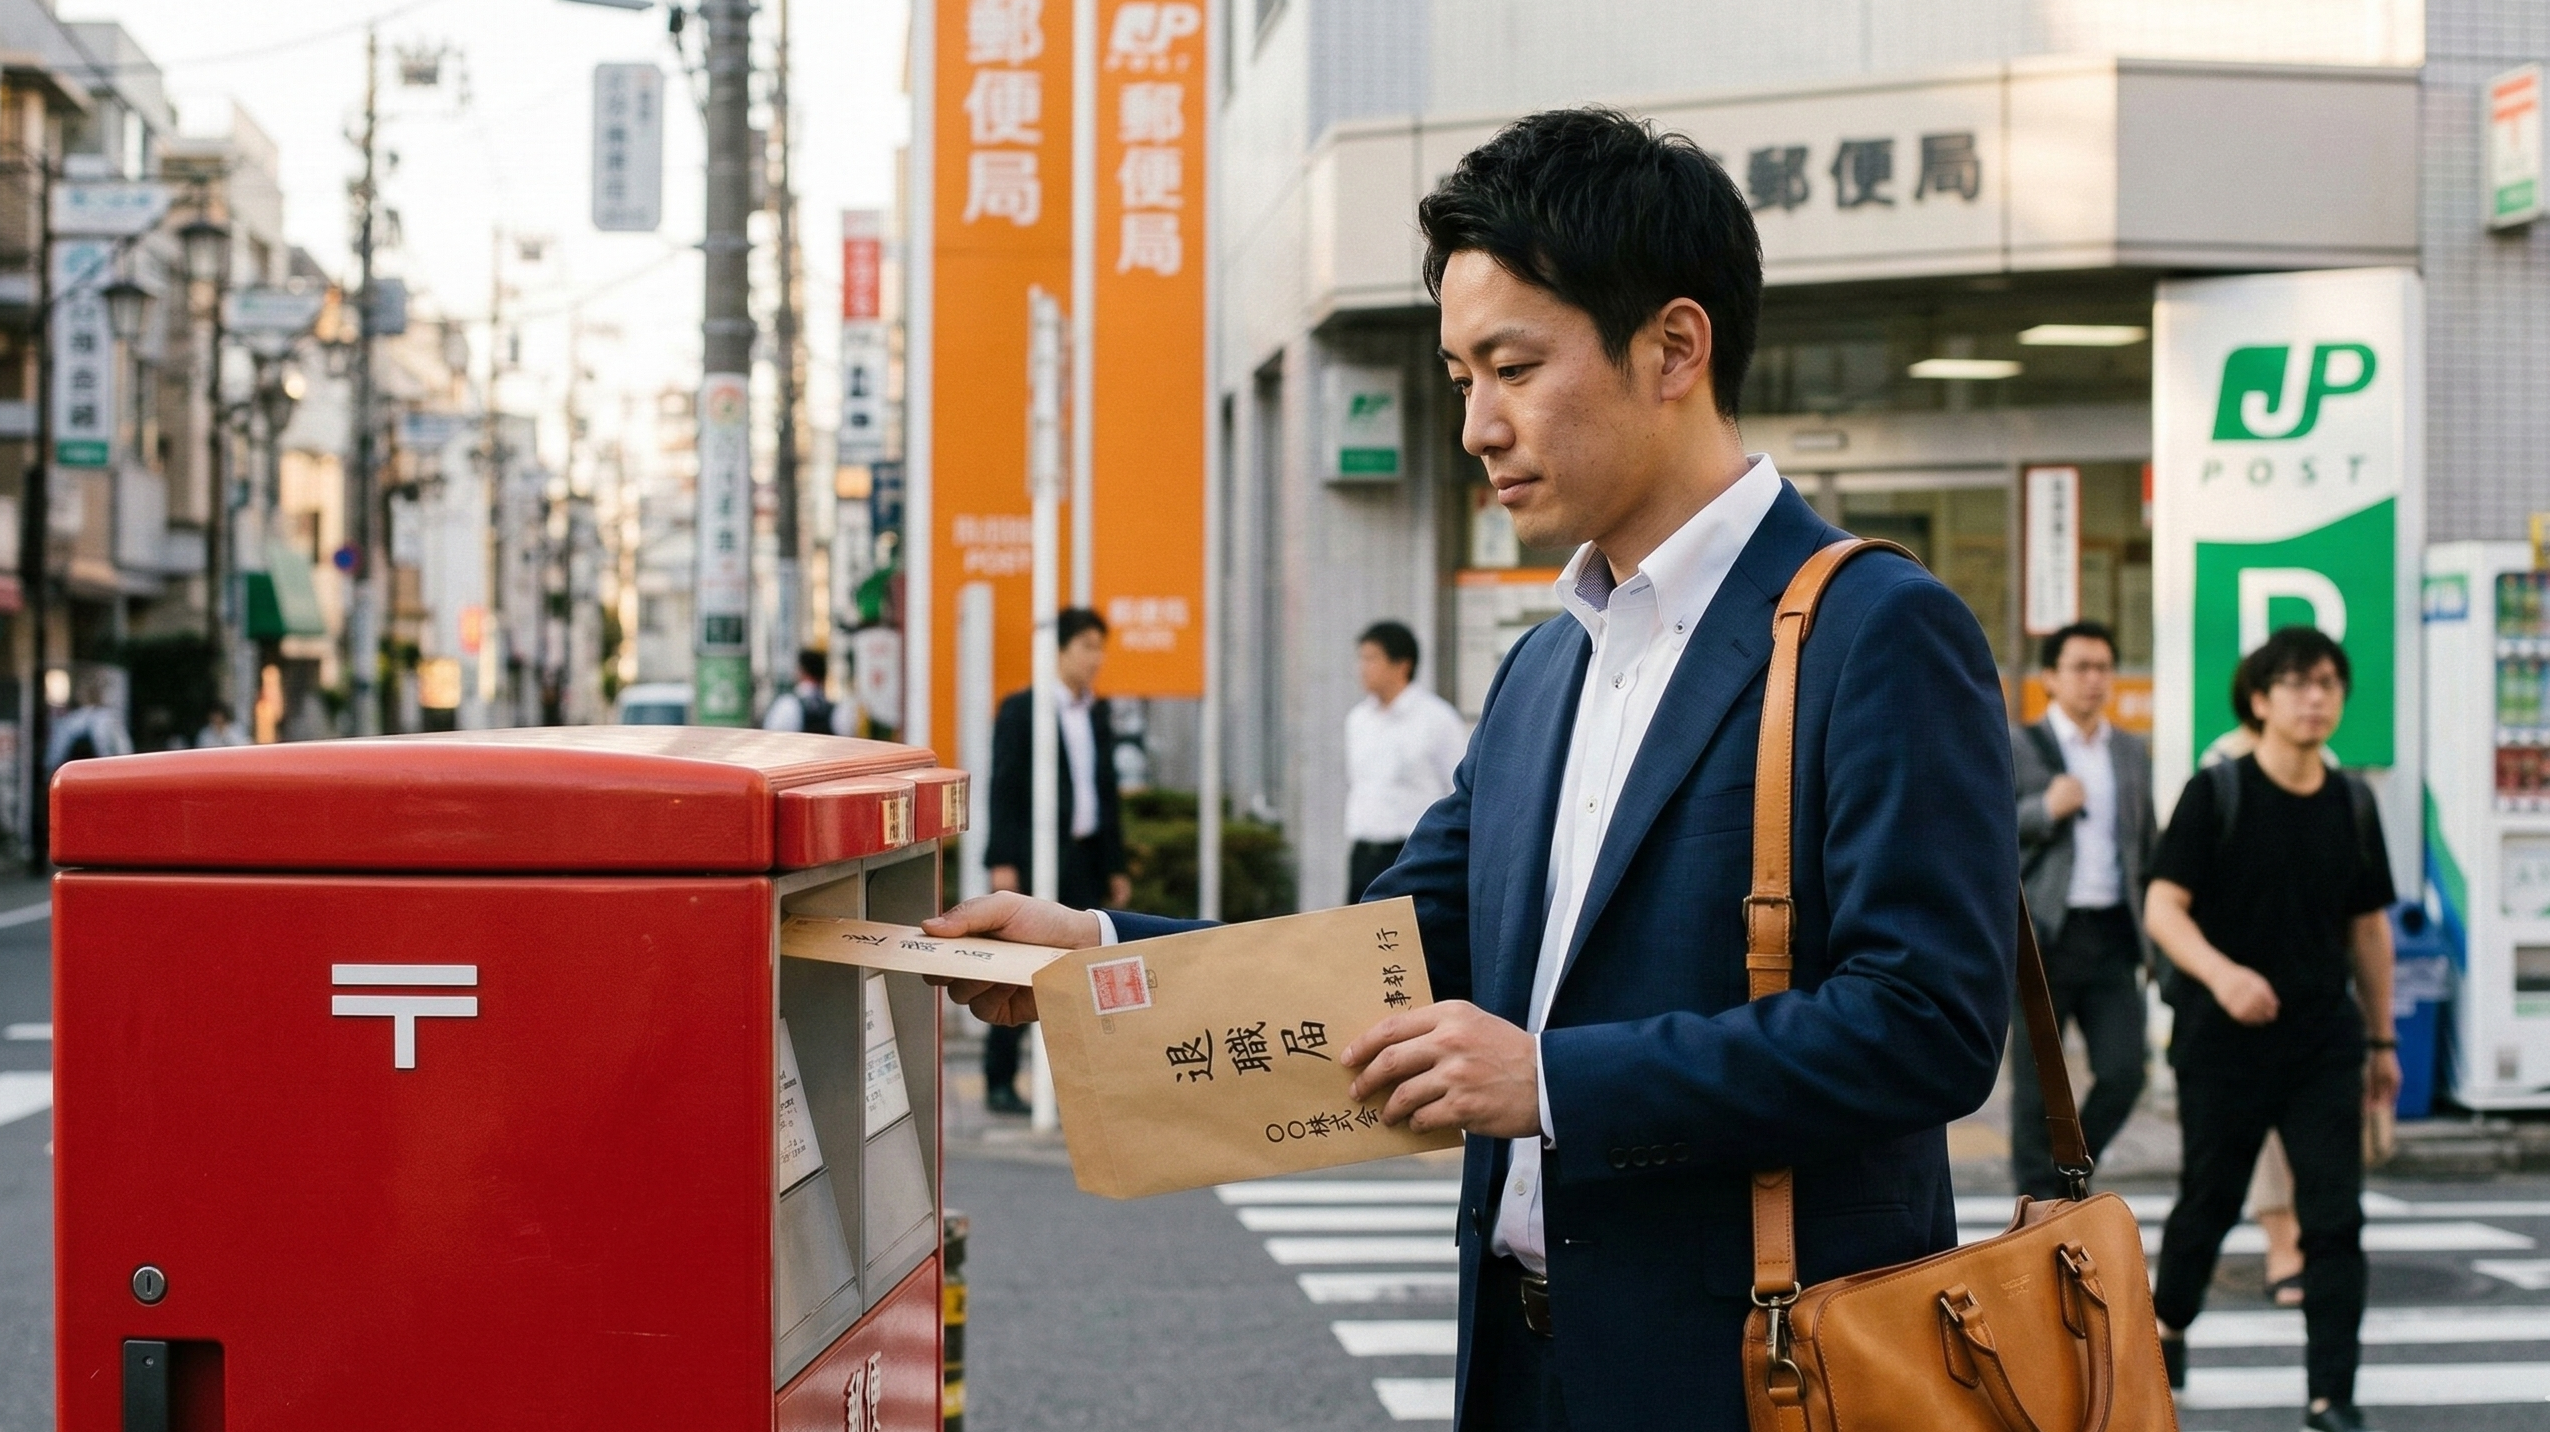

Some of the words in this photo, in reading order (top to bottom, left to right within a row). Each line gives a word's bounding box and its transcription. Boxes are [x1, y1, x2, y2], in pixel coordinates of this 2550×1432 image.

[1108, 4, 1201, 52] JP
[963, 0, 1045, 227] 郵便局
[1116, 82, 1186, 276] 郵便局
[1711, 130, 1983, 214] 郵便局
[2212, 343, 2377, 440] JP
[2202, 456, 2365, 486] POST
[1375, 927, 1400, 952] 行
[1382, 964, 1413, 1011] 事部
[1165, 1020, 1332, 1083] 退職届
